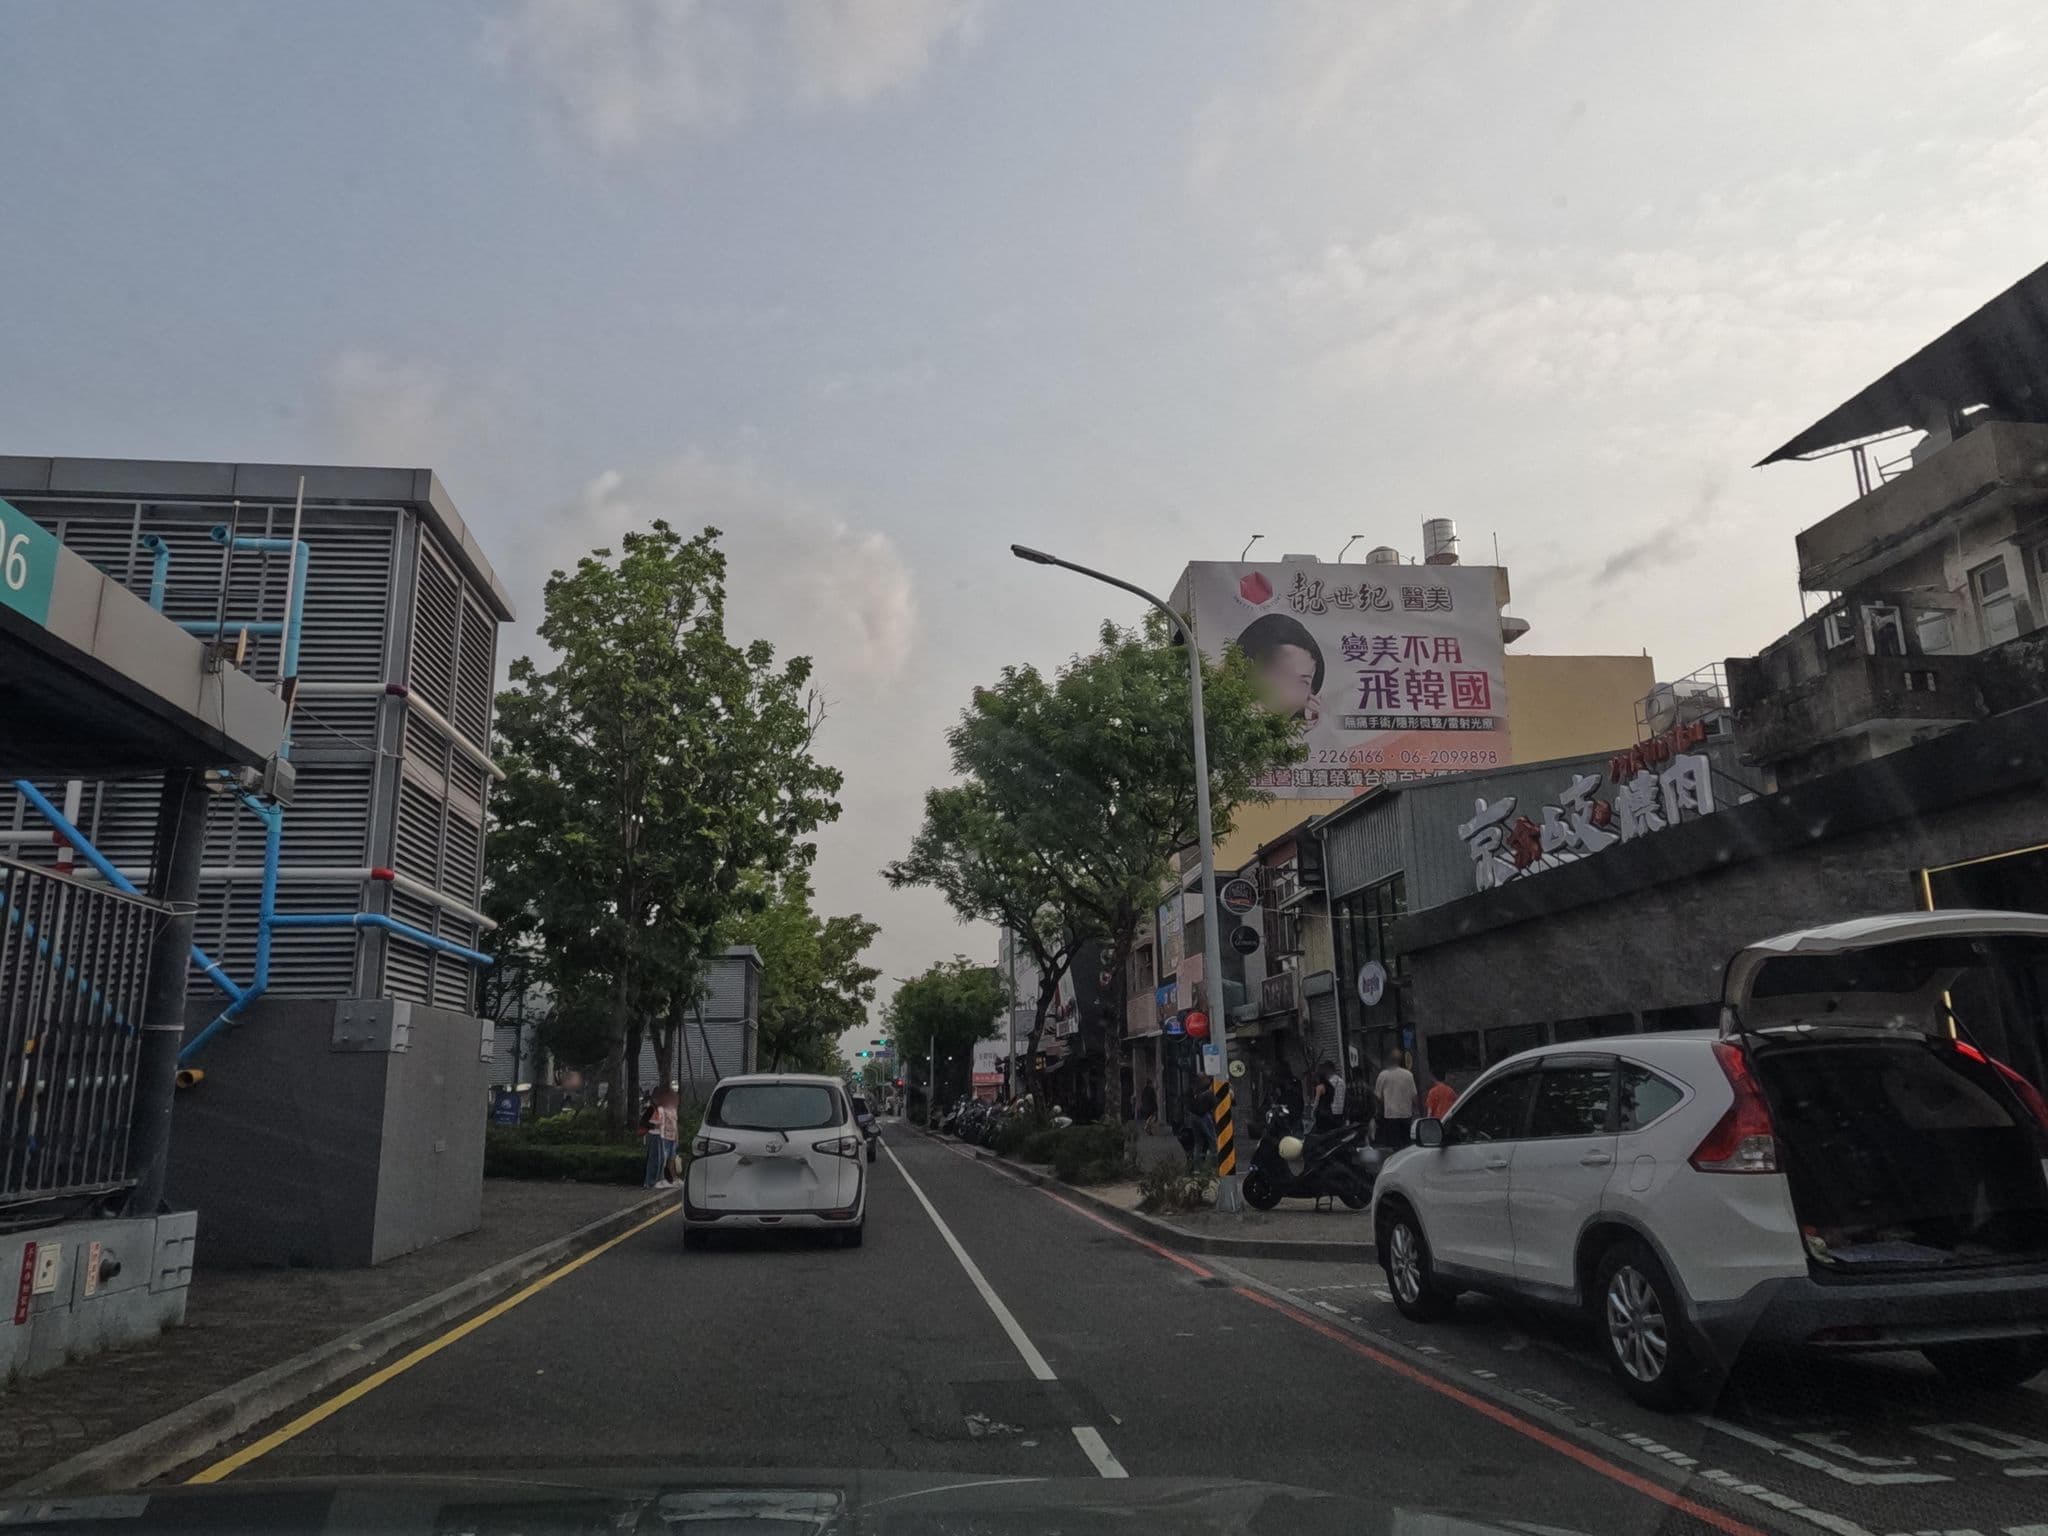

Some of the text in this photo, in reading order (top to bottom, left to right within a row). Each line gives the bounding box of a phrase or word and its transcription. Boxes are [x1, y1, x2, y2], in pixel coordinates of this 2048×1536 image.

[0, 517, 31, 591] 6
[1400, 586, 1452, 612] 醫美
[1341, 633, 1463, 666] 變美不用
[1357, 667, 1491, 711] 飛韓國
[1400, 750, 1498, 765] 06-2099898
